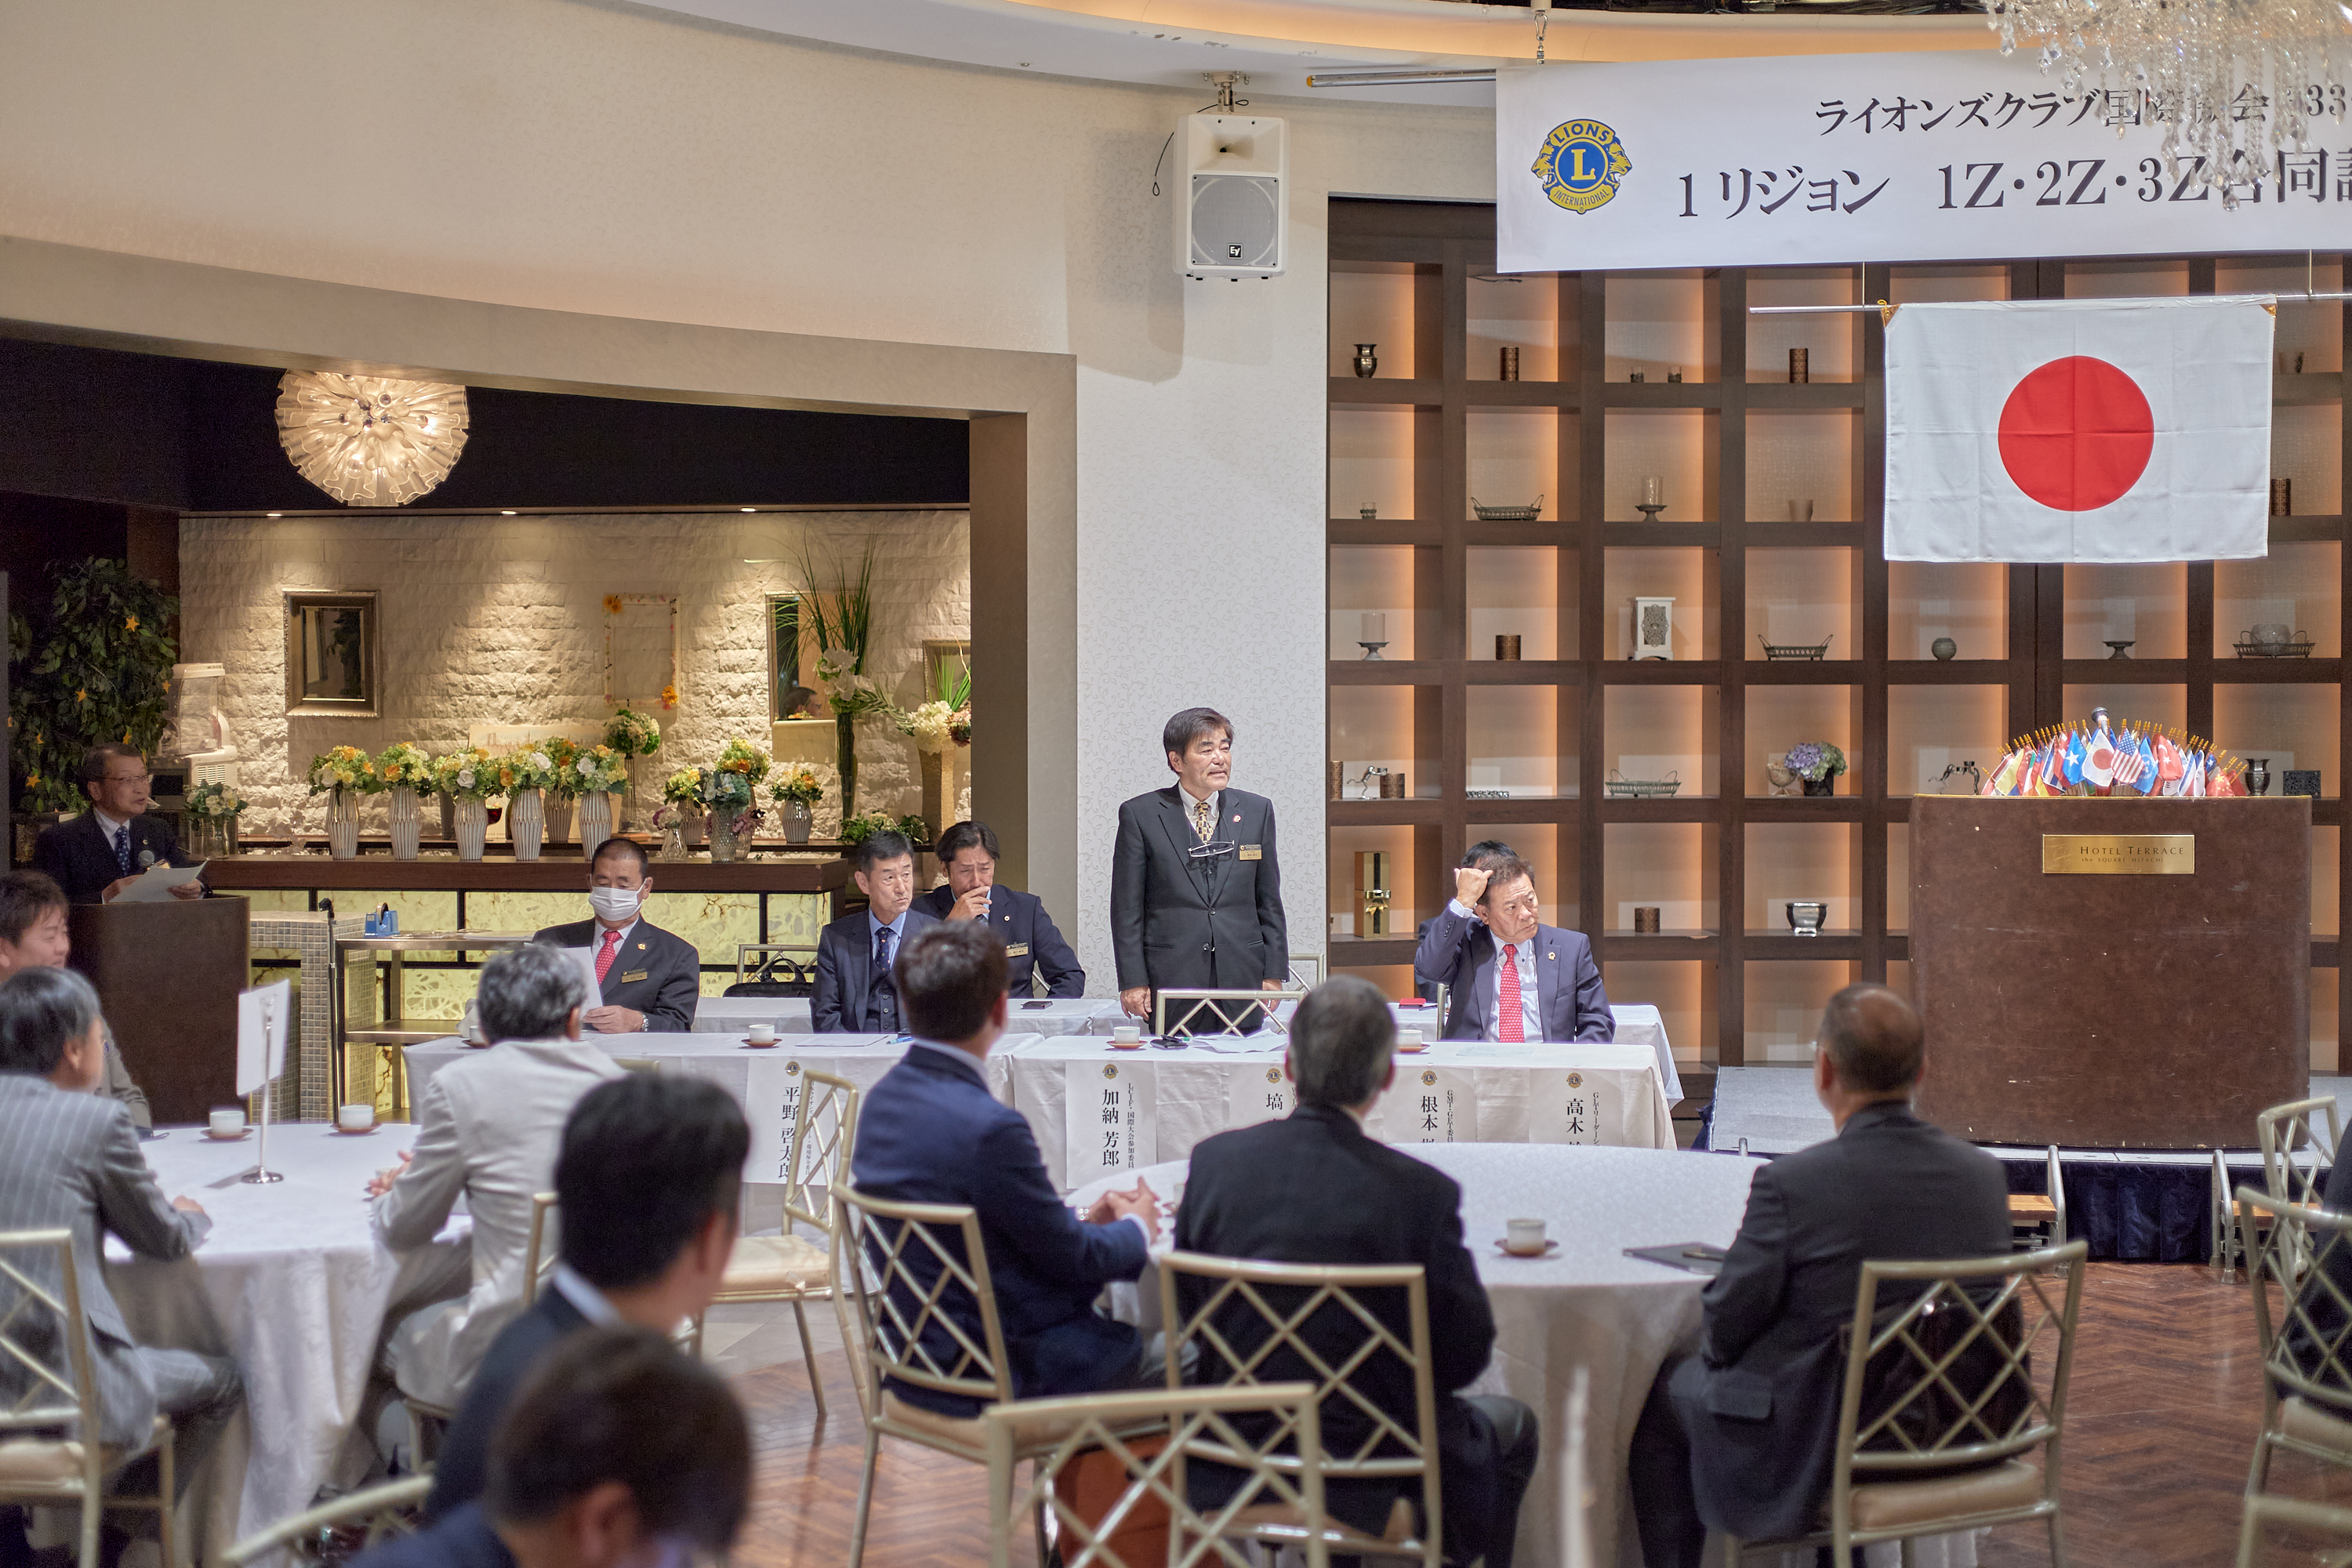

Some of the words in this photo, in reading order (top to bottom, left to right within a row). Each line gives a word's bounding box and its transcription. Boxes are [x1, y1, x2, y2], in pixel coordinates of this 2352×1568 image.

[1553, 122, 1610, 144] LIONS
[1571, 149, 1596, 180] L
[1553, 188, 1610, 207] INTERNATIONAL
[2080, 846, 2121, 855] HOTEL
[2127, 846, 2184, 855] TERRACE
[782, 1086, 800, 1120] 平野
[1102, 1089, 1120, 1124] 加納
[1420, 1095, 1438, 1131] 根本
[1566, 1098, 1584, 1134] 高木
[1102, 1131, 1120, 1167] 芳郎
